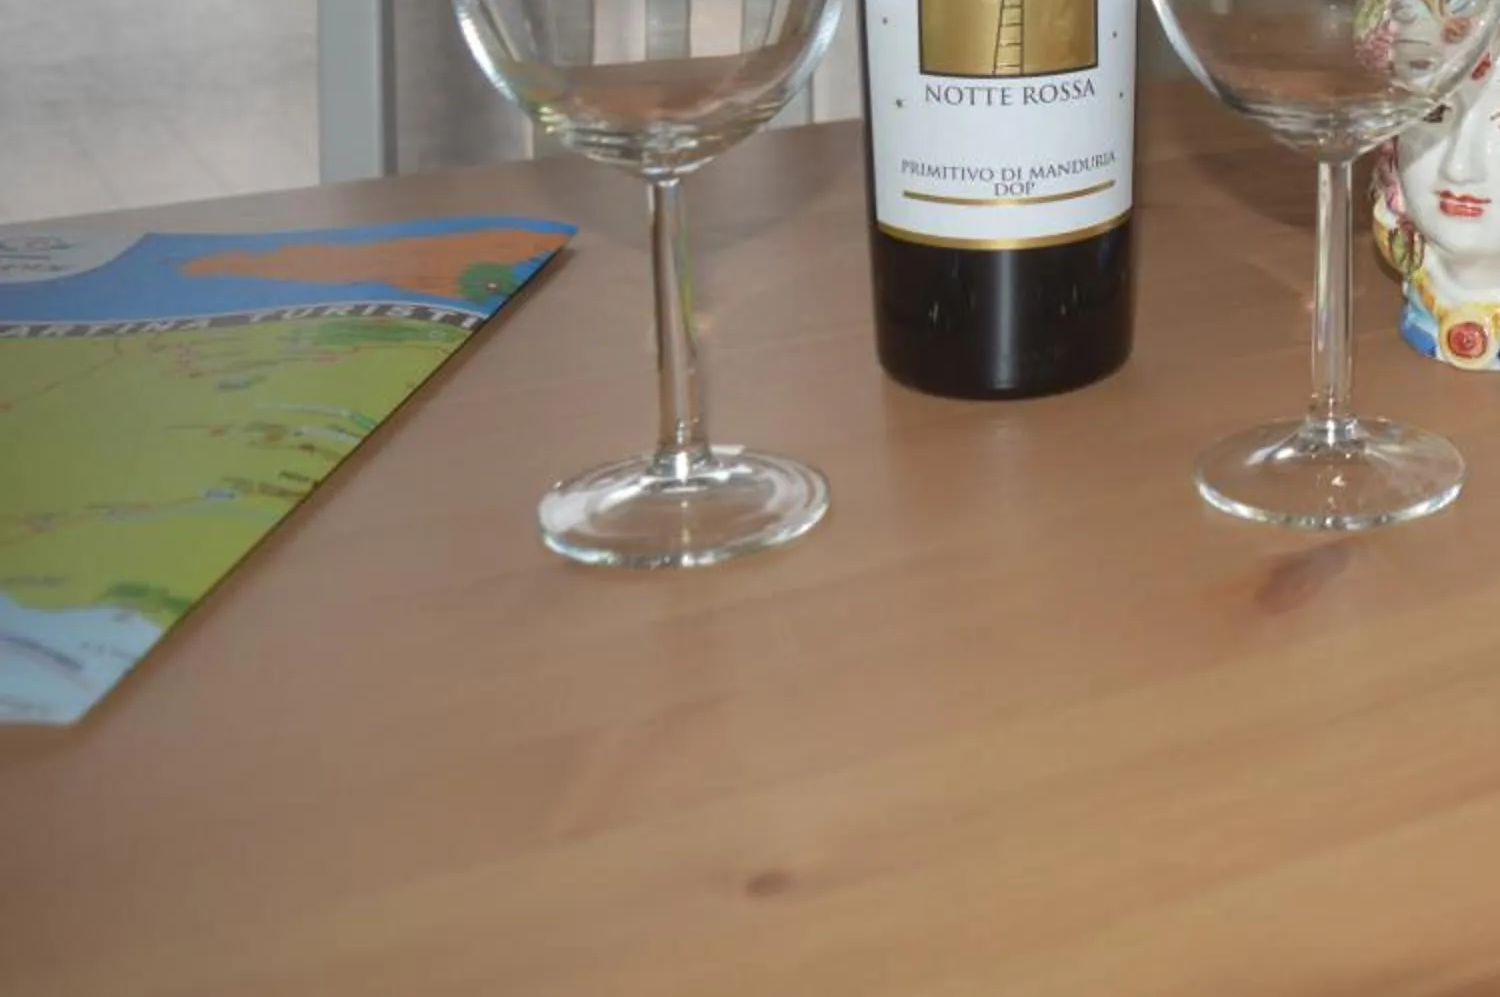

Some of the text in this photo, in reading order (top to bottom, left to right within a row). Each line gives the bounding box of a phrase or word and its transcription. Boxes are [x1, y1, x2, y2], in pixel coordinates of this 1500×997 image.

[924, 77, 1096, 107] NOTTE ROSSA
[901, 152, 1117, 182] PRIMITIVO DI MANDURIA
[994, 182, 1036, 196] DOP
